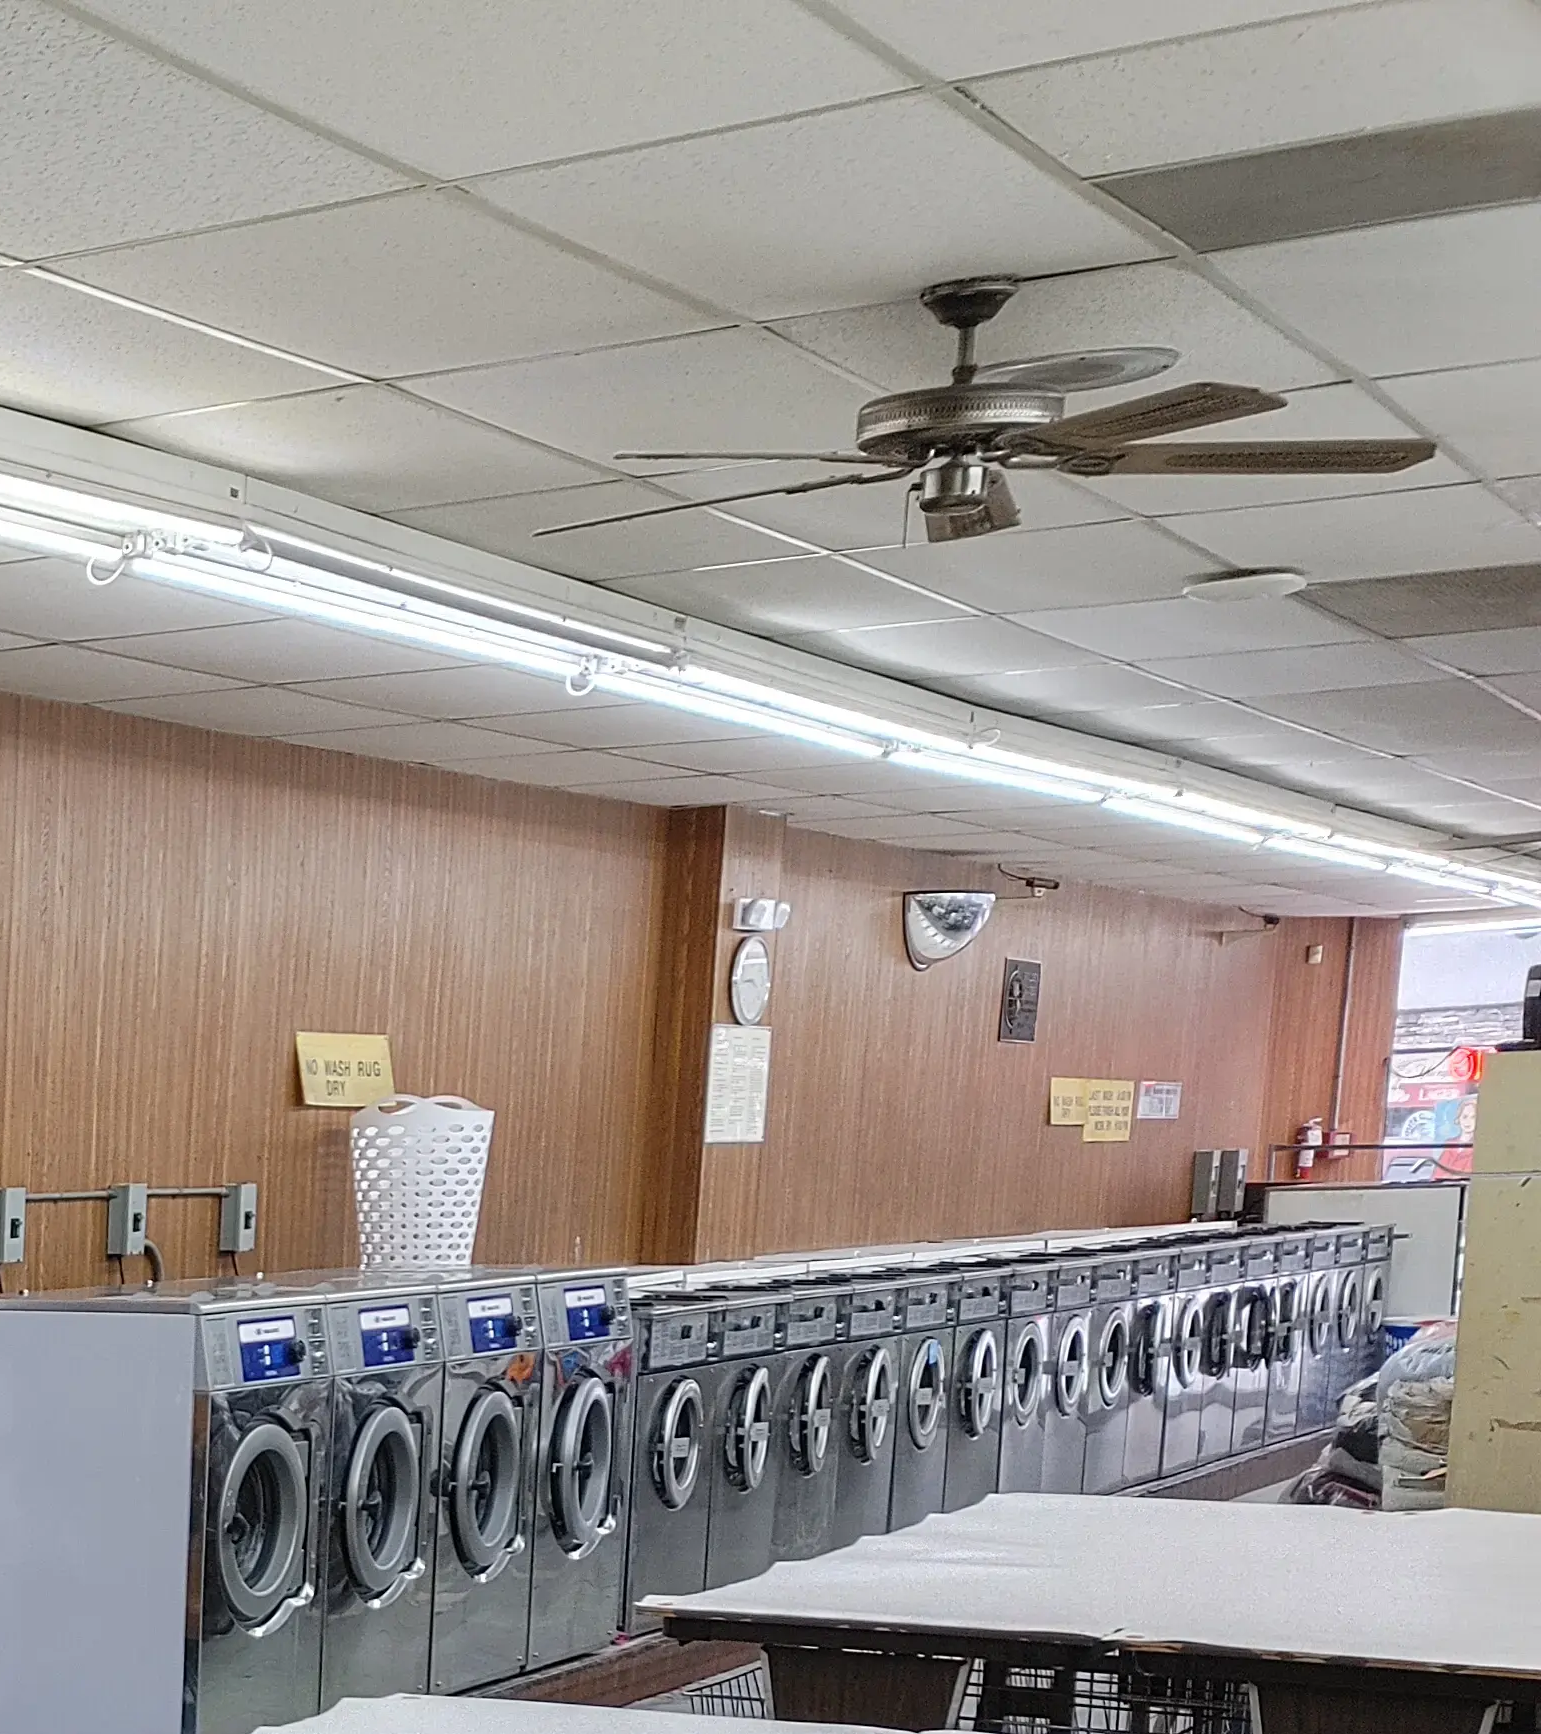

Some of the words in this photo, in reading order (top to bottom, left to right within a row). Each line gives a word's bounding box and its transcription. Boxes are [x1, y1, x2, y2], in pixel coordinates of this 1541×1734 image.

[305, 1058, 318, 1075] NO
[324, 1060, 351, 1077] WASH
[357, 1061, 381, 1077] RUG
[326, 1079, 346, 1096] DRY
